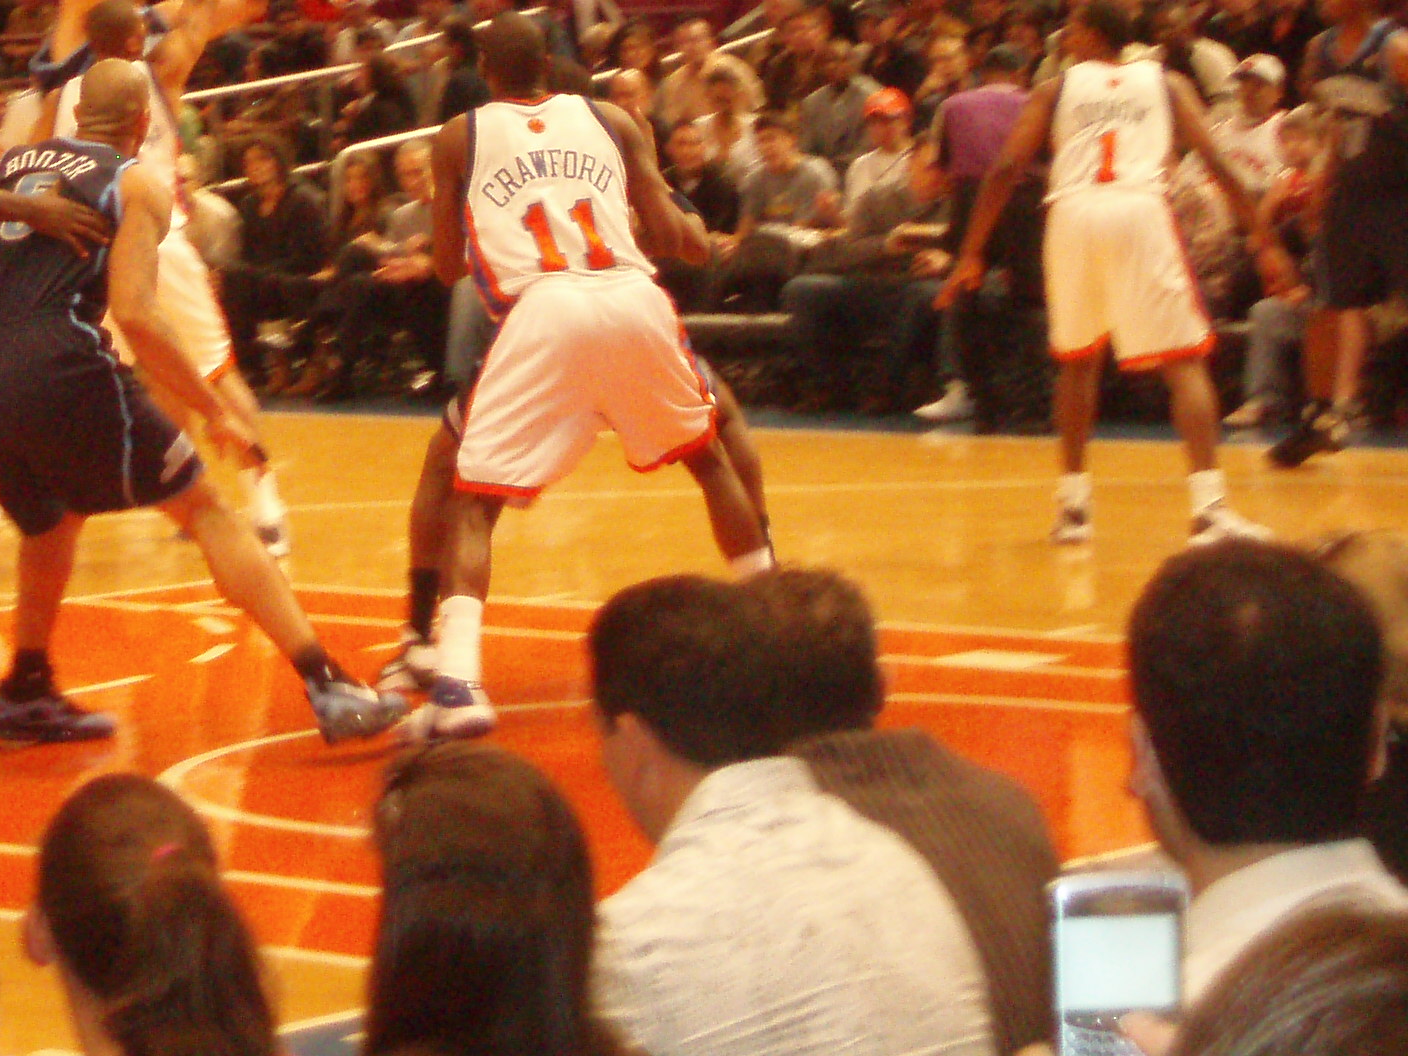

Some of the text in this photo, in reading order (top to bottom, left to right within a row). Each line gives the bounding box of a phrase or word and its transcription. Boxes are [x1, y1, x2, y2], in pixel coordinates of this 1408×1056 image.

[4, 148, 98, 181] BOOZER
[481, 149, 613, 208] CRAWFORD
[1096, 129, 1118, 183] 1
[521, 198, 617, 272] 11
